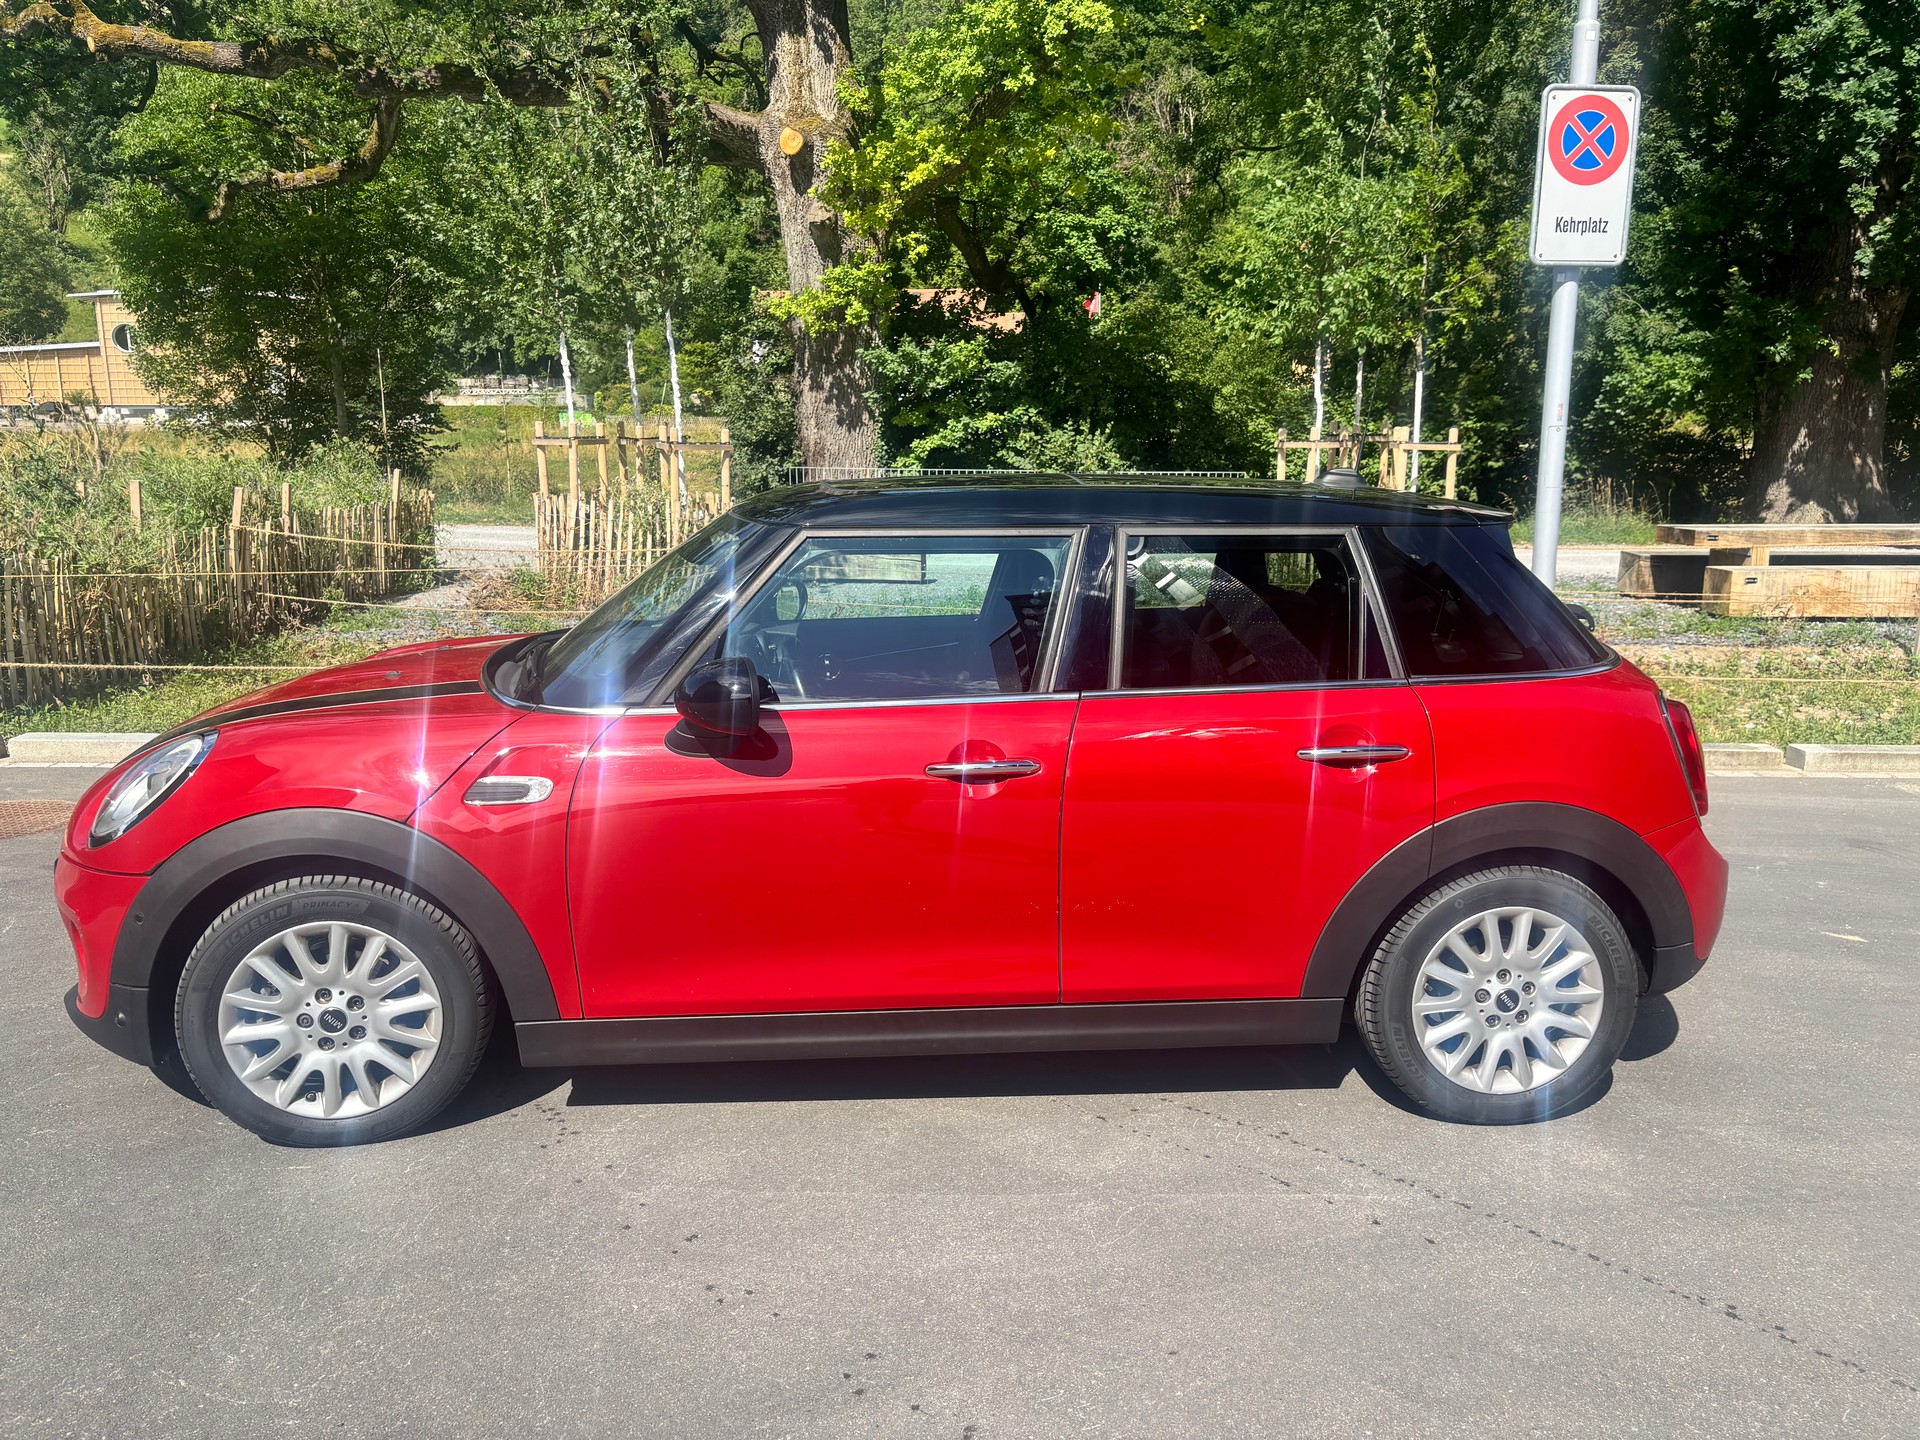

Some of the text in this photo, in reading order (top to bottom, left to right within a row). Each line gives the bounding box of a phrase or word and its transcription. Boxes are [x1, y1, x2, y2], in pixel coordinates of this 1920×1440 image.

[1555, 216, 1609, 236] Kehrplatz
[303, 900, 353, 909] PRIMACY
[213, 905, 288, 960] MICHELIN
[1500, 993, 1515, 1009] MINI
[323, 1013, 343, 1029] MINI
